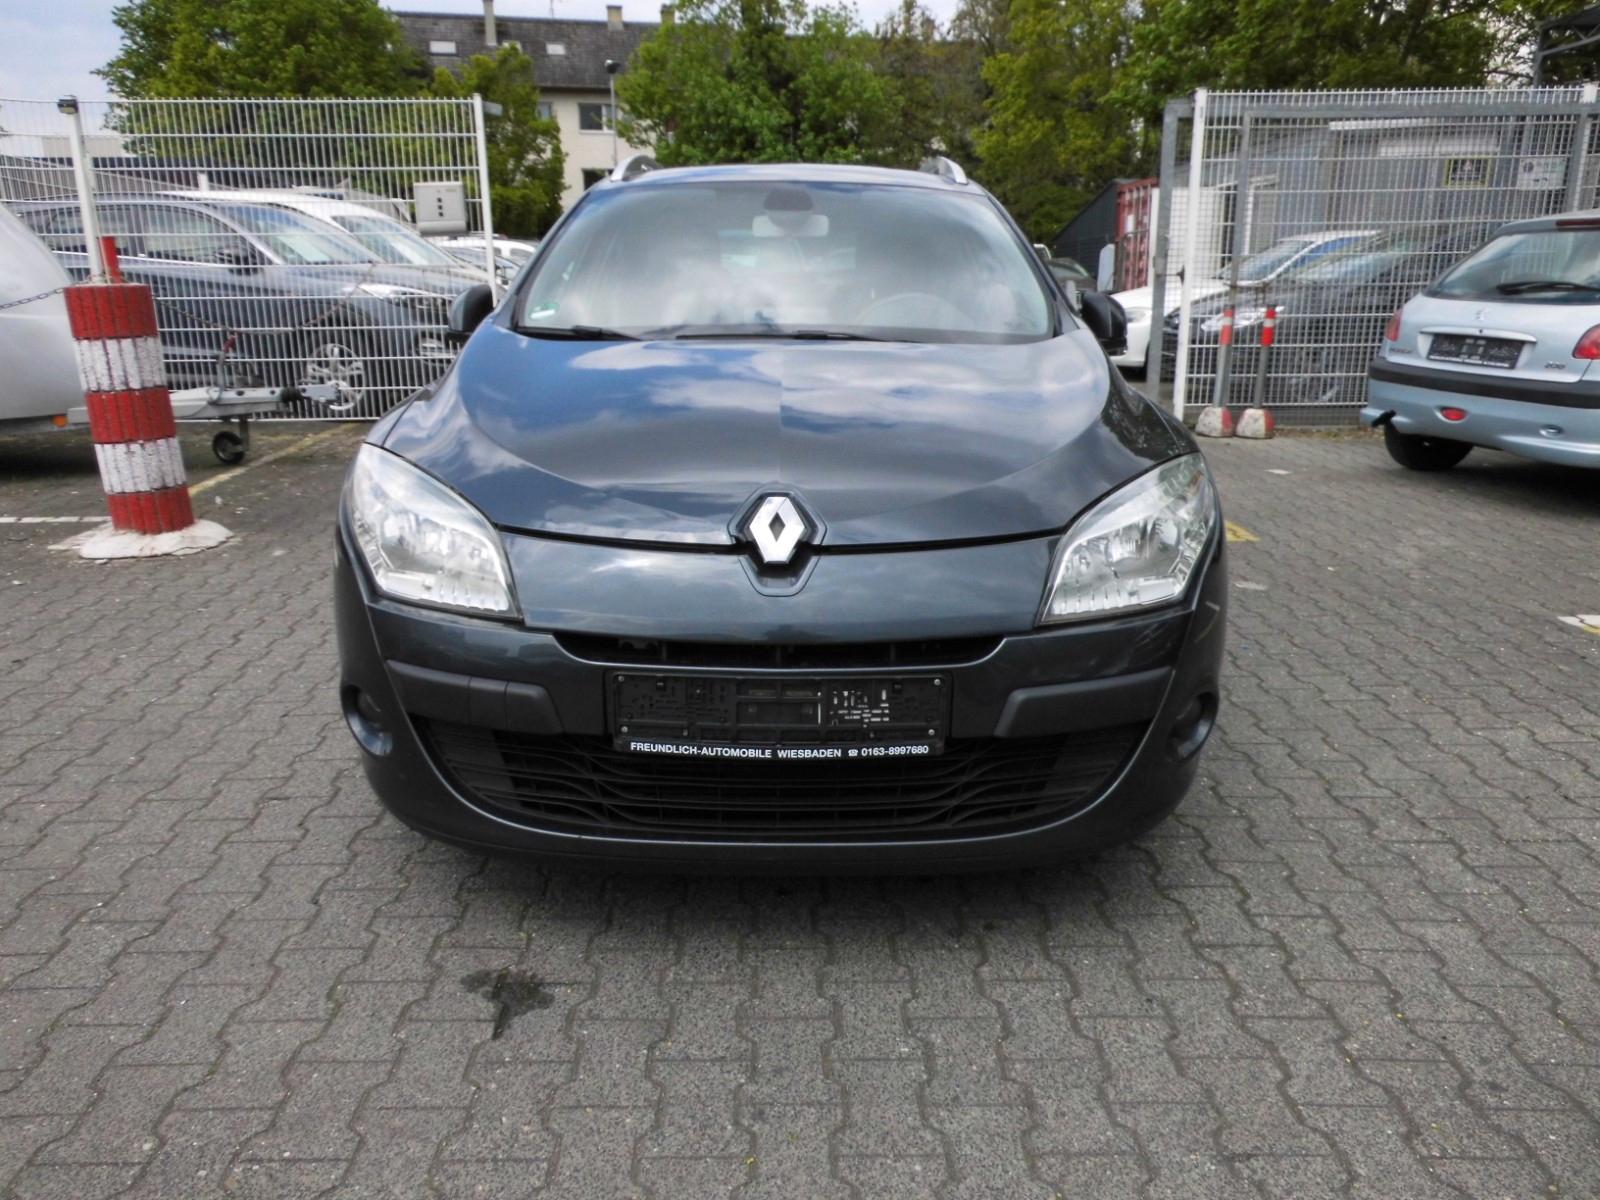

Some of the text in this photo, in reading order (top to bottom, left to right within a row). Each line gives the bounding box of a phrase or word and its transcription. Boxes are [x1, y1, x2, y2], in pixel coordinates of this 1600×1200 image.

[630, 742, 929, 758] FREUNDLICH-AUTOMOBILE WIESBADEN 0163-8997680
